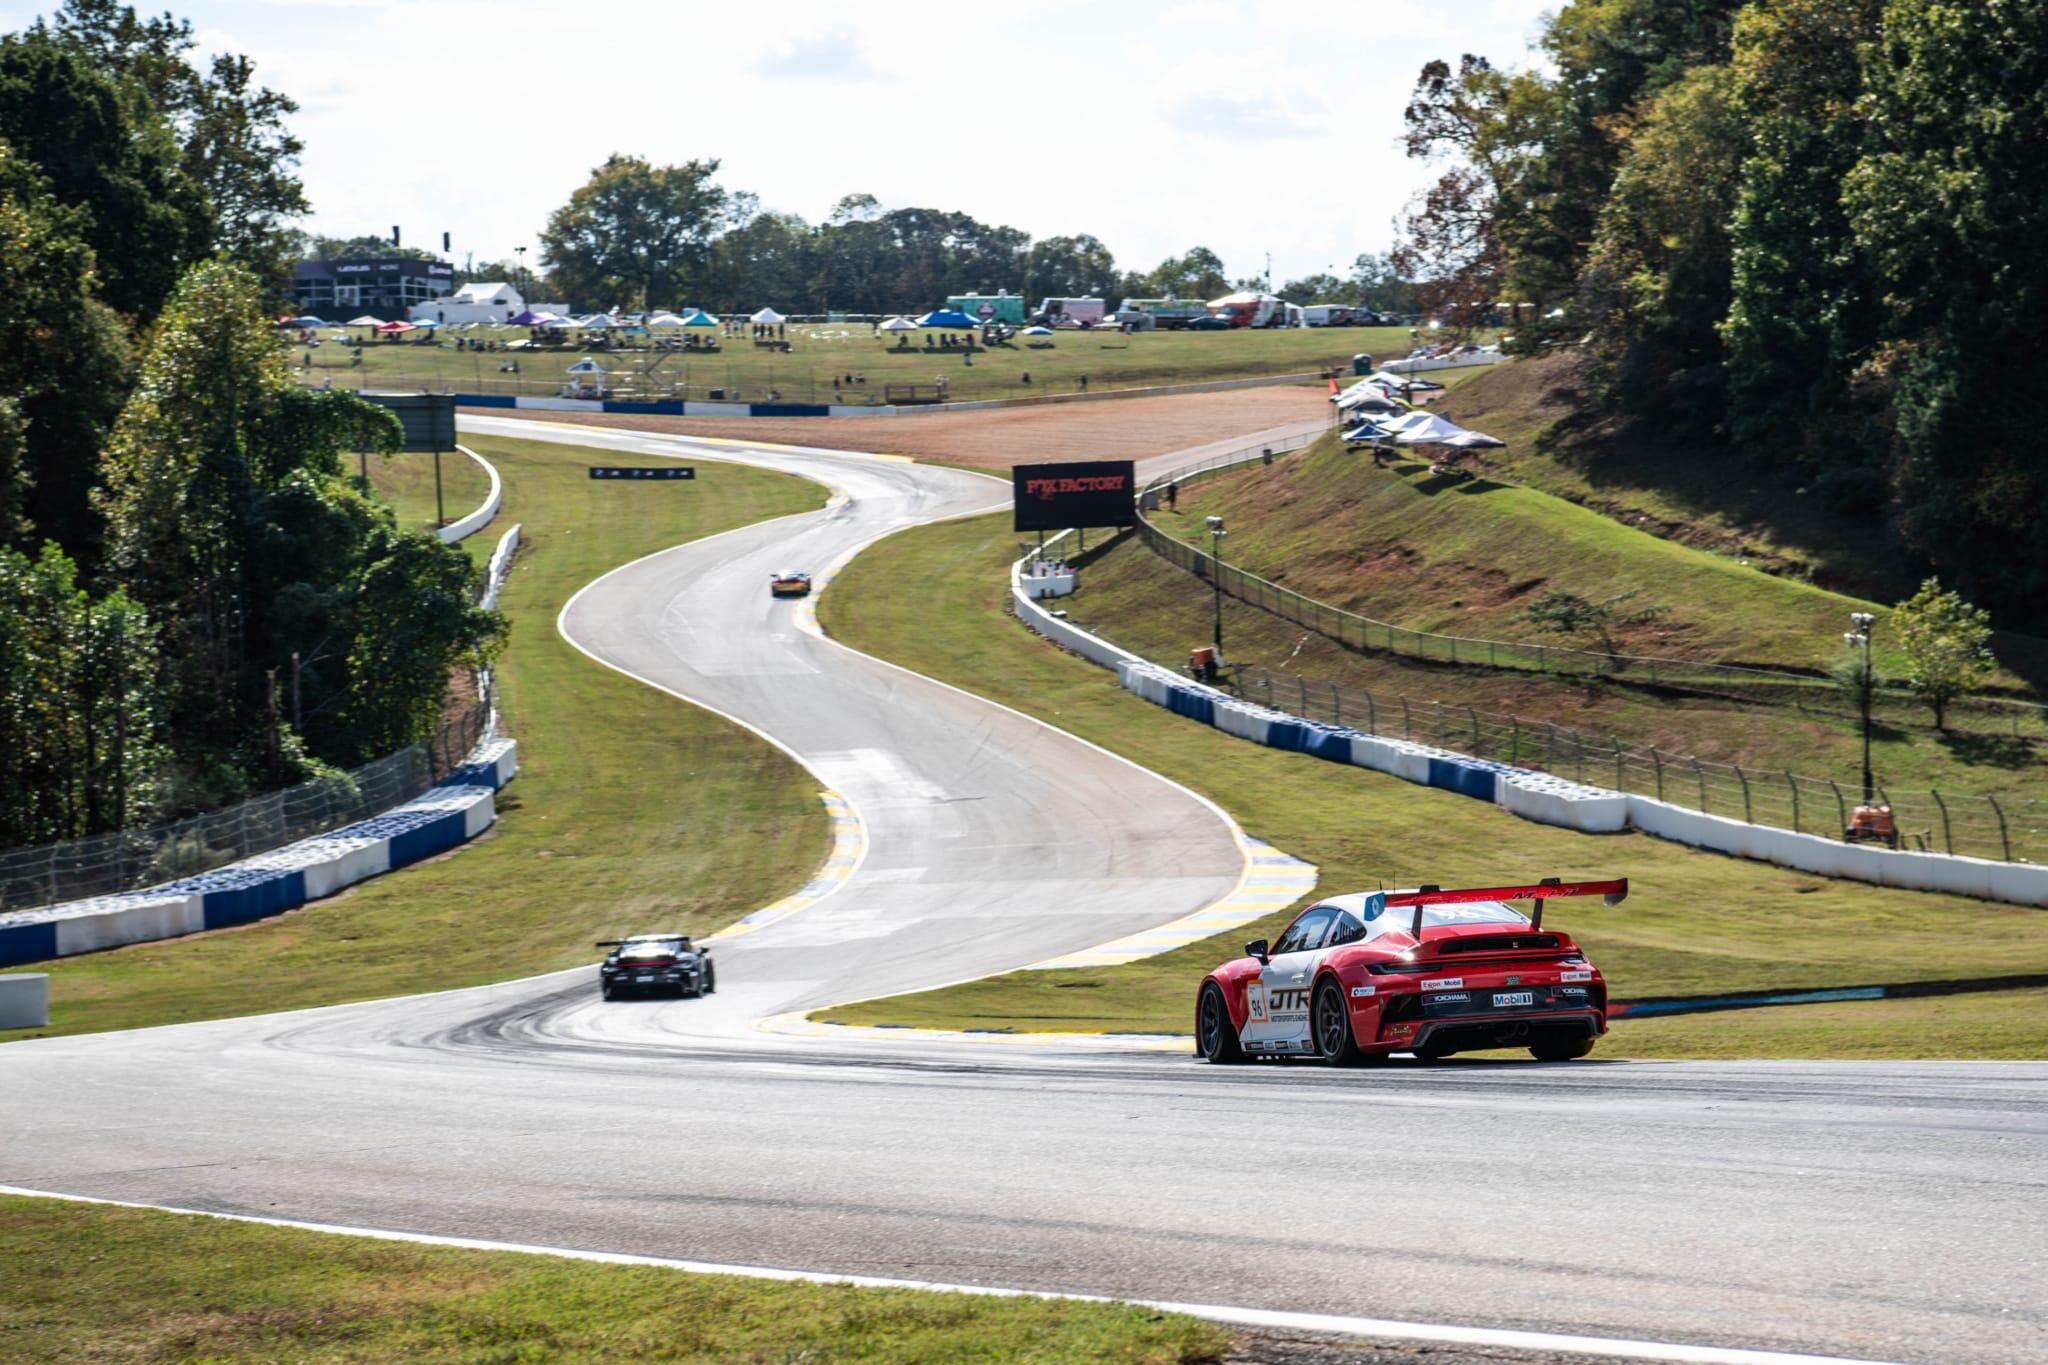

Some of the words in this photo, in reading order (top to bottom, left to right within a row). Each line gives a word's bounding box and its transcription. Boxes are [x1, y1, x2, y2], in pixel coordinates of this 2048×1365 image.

[1059, 476, 1124, 492] FACTORY
[1434, 993, 1468, 1002] YOKOHAMA
[1495, 993, 1522, 1007] Mobil
[1251, 999, 1263, 1017] 96
